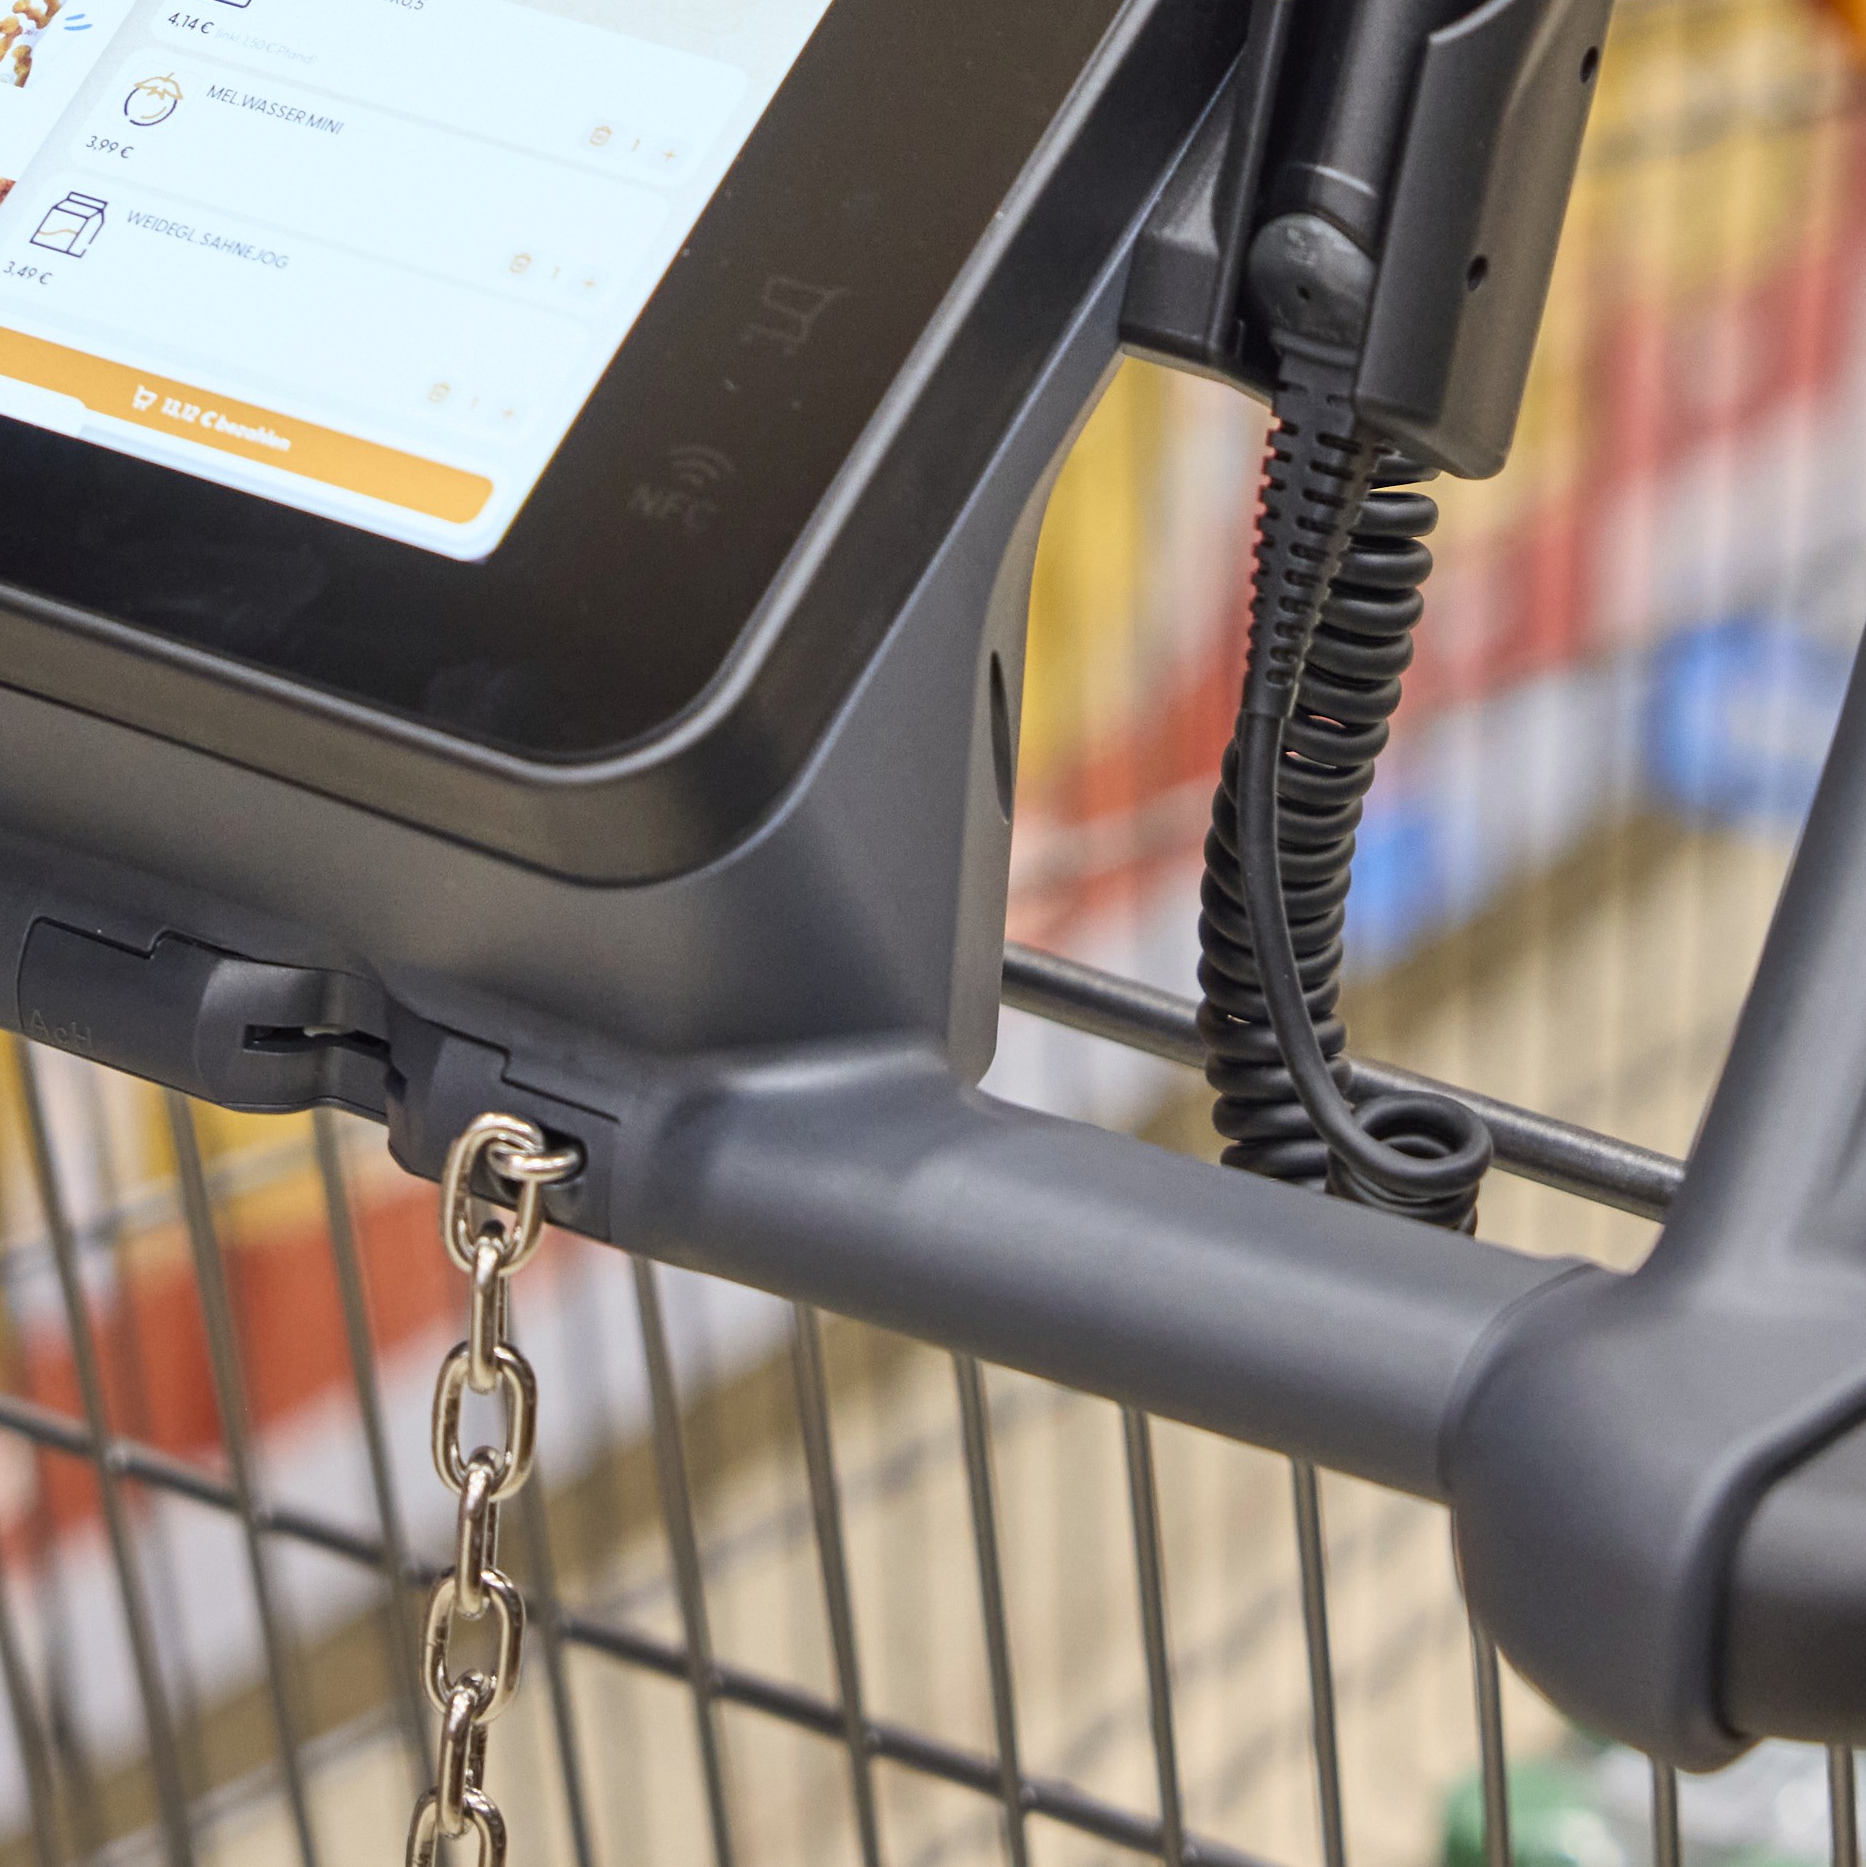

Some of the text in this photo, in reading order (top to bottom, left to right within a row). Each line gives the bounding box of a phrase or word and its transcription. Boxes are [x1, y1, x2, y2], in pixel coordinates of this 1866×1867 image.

[168, 11, 215, 34] 4,14 €
[206, 85, 344, 135] MEL.WASSER MINI
[85, 135, 135, 160] 3,99 €
[127, 209, 291, 270] WEIDEGL.SAHNEJOG
[3, 260, 53, 286] 3,49 €
[627, 480, 720, 534] NFC
